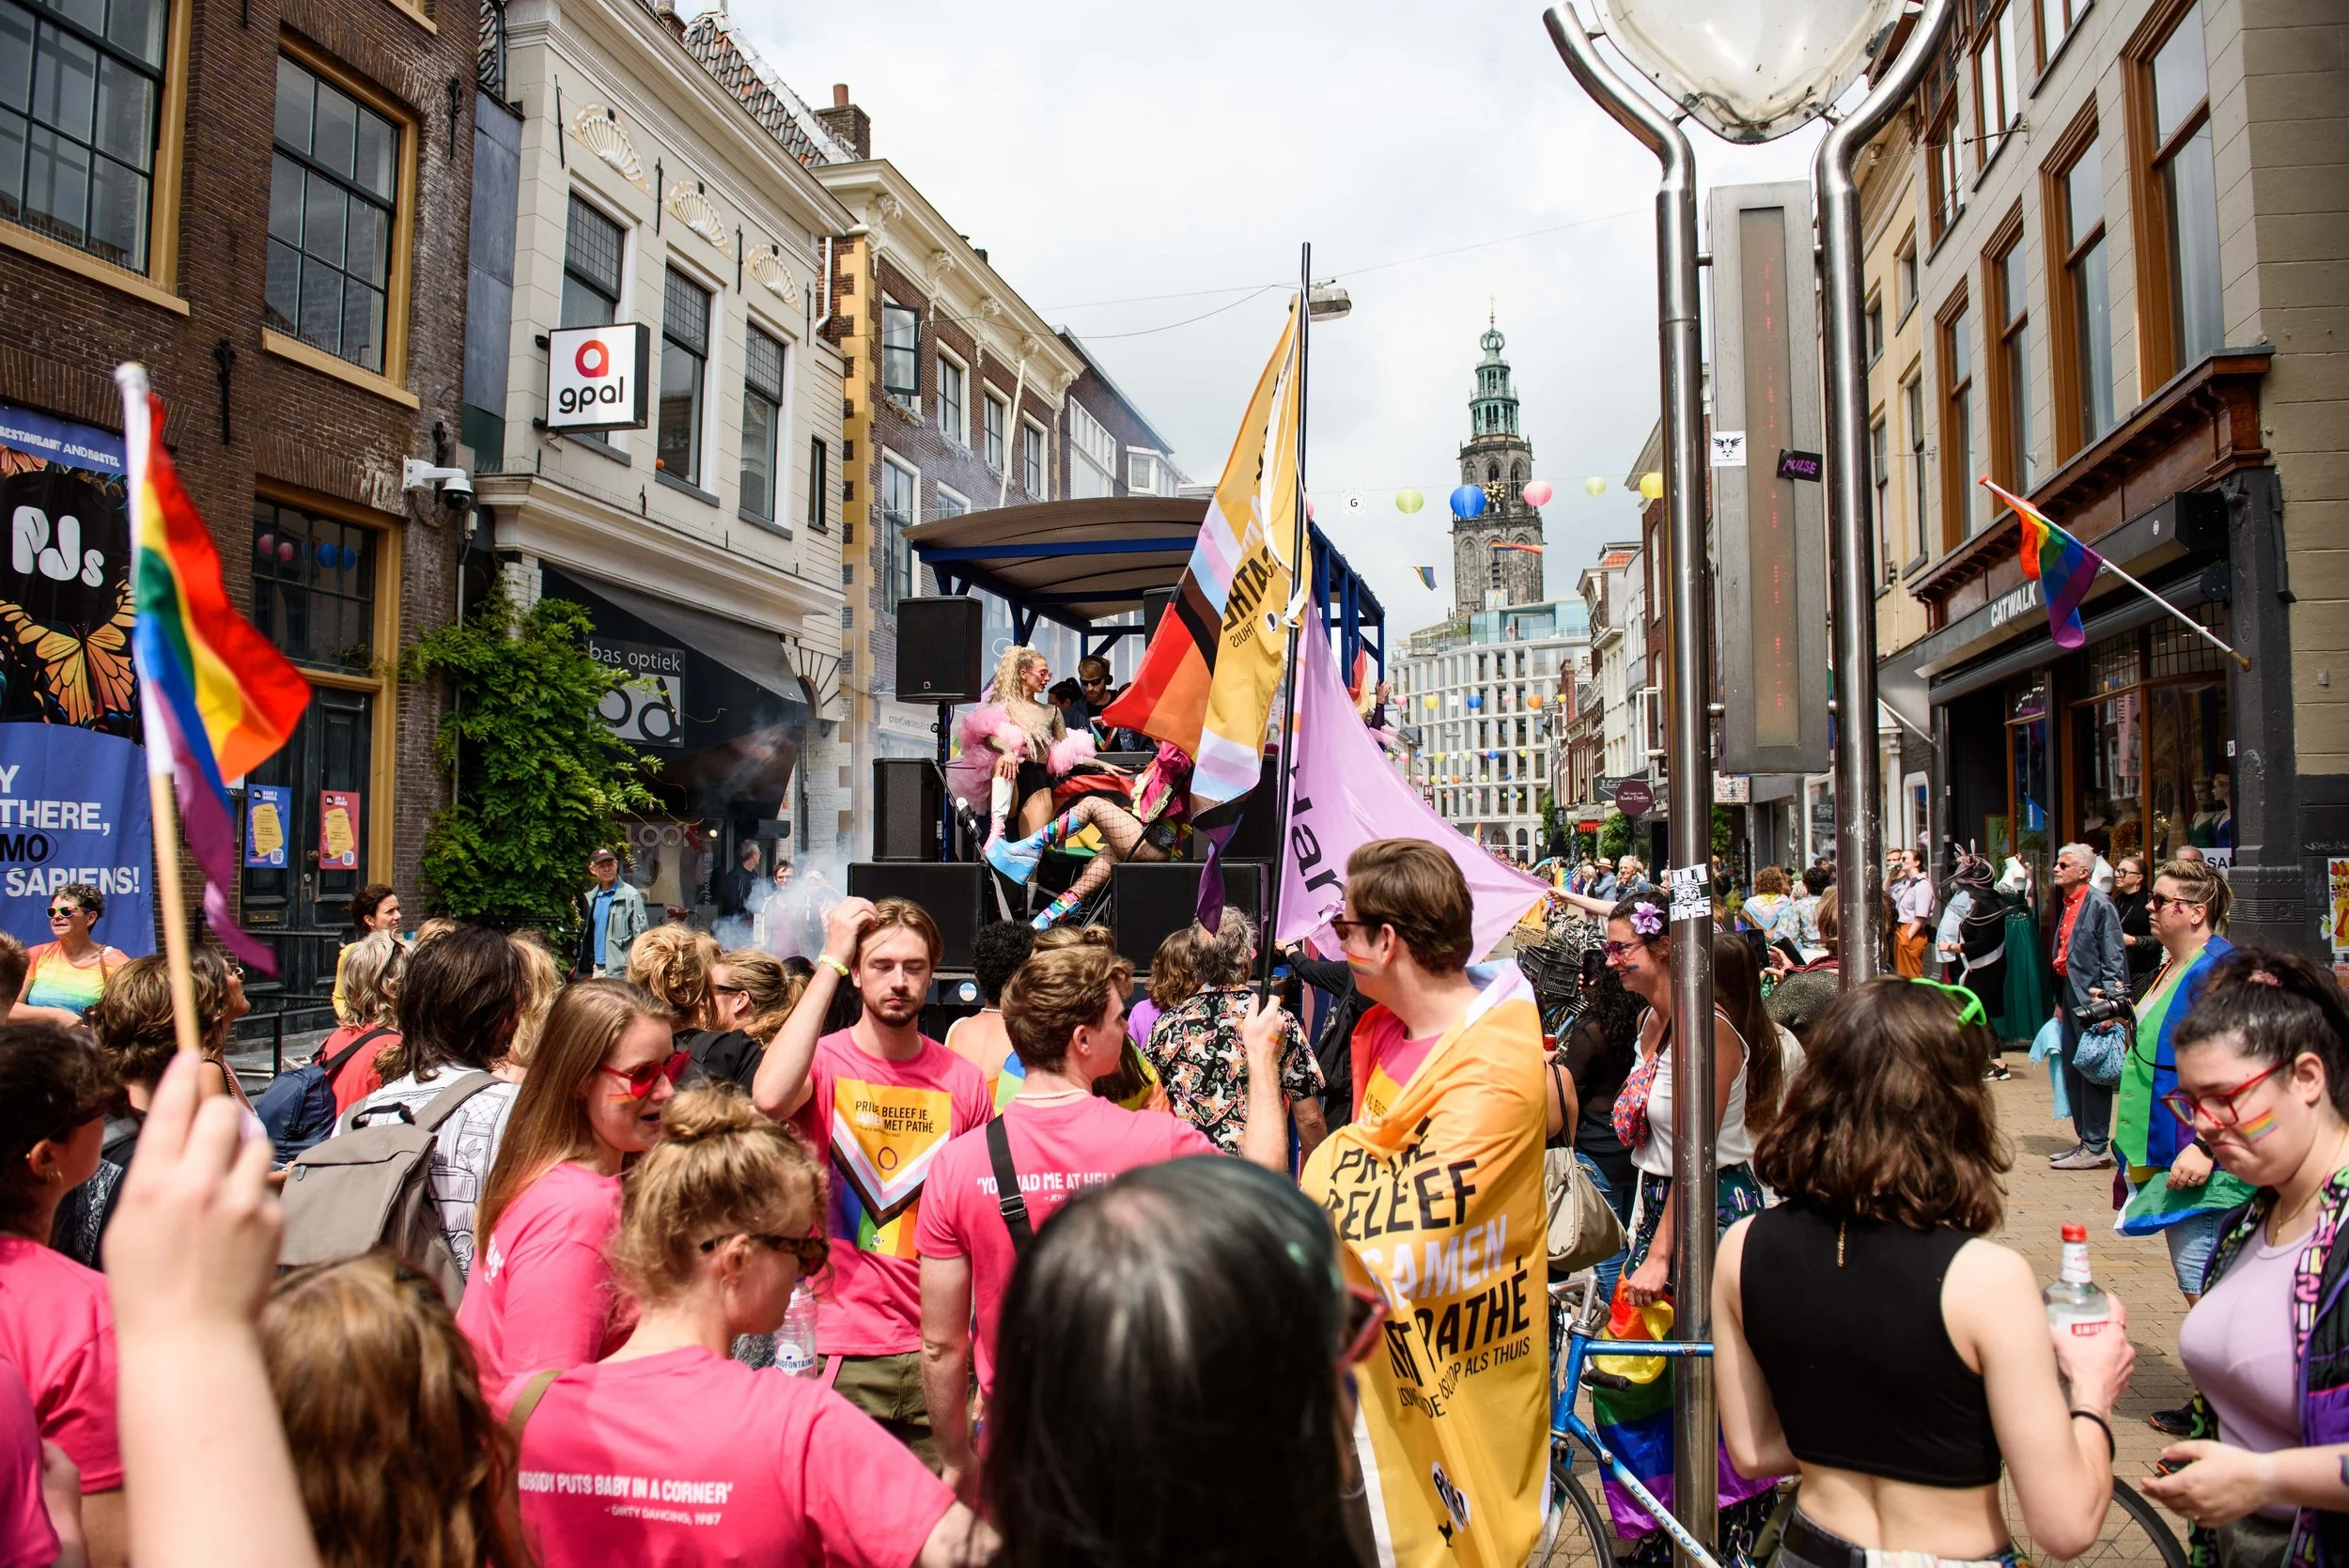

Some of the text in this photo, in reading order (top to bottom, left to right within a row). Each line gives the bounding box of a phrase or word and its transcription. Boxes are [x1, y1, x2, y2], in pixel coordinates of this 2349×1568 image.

[559, 376, 624, 414] gpal
[63, 443, 89, 458] AND
[87, 449, 120, 468] HOSTEL
[1781, 458, 1817, 475] PULSE
[1350, 498, 1358, 507] G
[12, 505, 104, 587] PJs
[1991, 581, 2037, 628] CATWALK
[628, 653, 681, 672] optiek
[0, 799, 111, 836] THERE,
[6, 866, 140, 897] SAPIENS!
[881, 1107, 916, 1119] BELEEF
[918, 1109, 927, 1120] JE
[884, 1119, 903, 1131] MET
[906, 1119, 934, 1133] PATHÉ
[977, 1175, 999, 1195] 'YO
[1043, 1172, 1064, 1190] ME
[1066, 1173, 1081, 1189] AT
[1414, 1254, 1531, 1374] PATHÉ
[1465, 1351, 1489, 1378] ALS
[1493, 1336, 1531, 1371] THUIS
[557, 1472, 592, 1494] PUTS
[595, 1474, 630, 1498] BABY
[632, 1477, 646, 1498] IN
[649, 1479, 661, 1499] A
[661, 1480, 733, 1504] CORNER'
[612, 1505, 641, 1517] DIRTY
[642, 1509, 692, 1526] DANCING,
[694, 1513, 722, 1526] 1987
